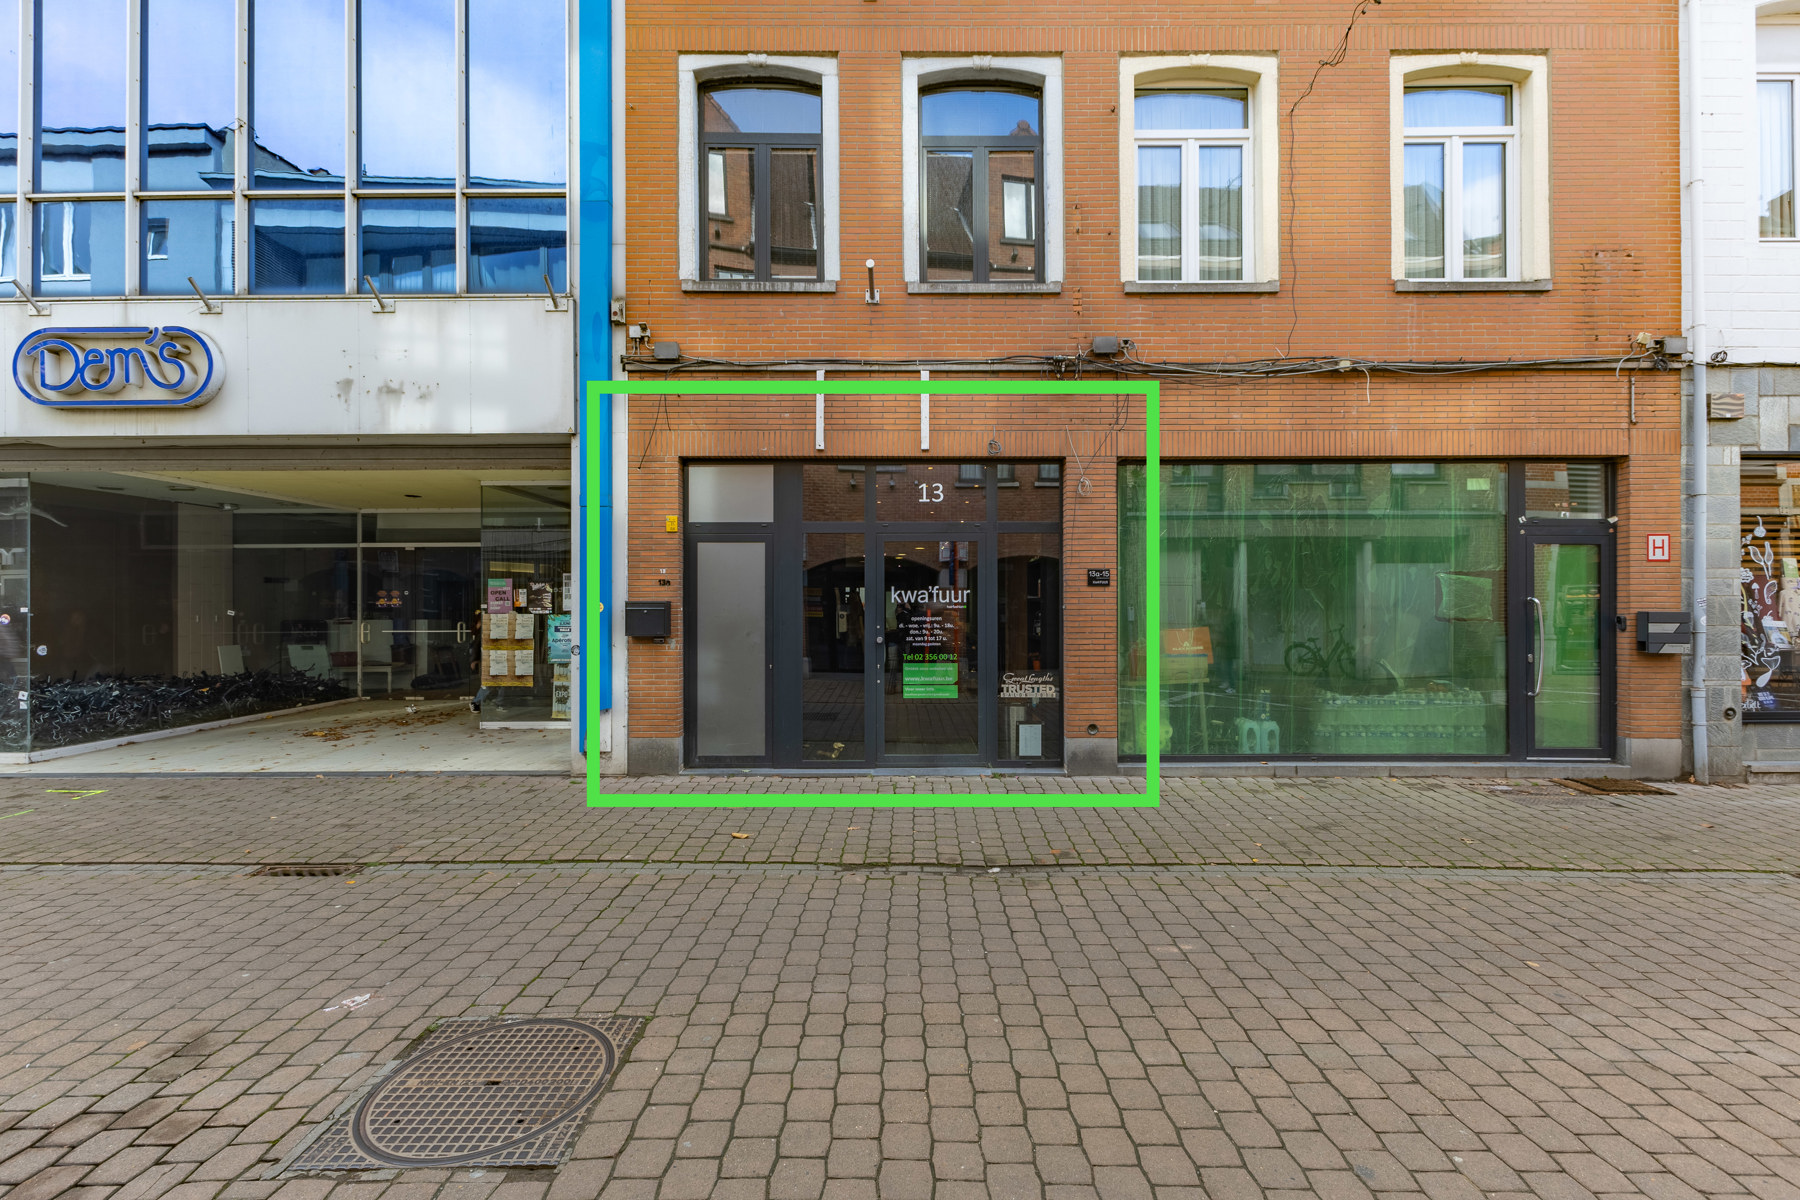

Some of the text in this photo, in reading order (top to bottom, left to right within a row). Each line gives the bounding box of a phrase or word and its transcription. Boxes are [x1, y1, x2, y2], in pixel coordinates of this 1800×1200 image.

[27, 327, 186, 391] Dem's
[918, 483, 944, 503] 13
[1652, 538, 1665, 557] H
[891, 585, 971, 604] kwa'fuur
[1001, 684, 1056, 694] TRUSTED
